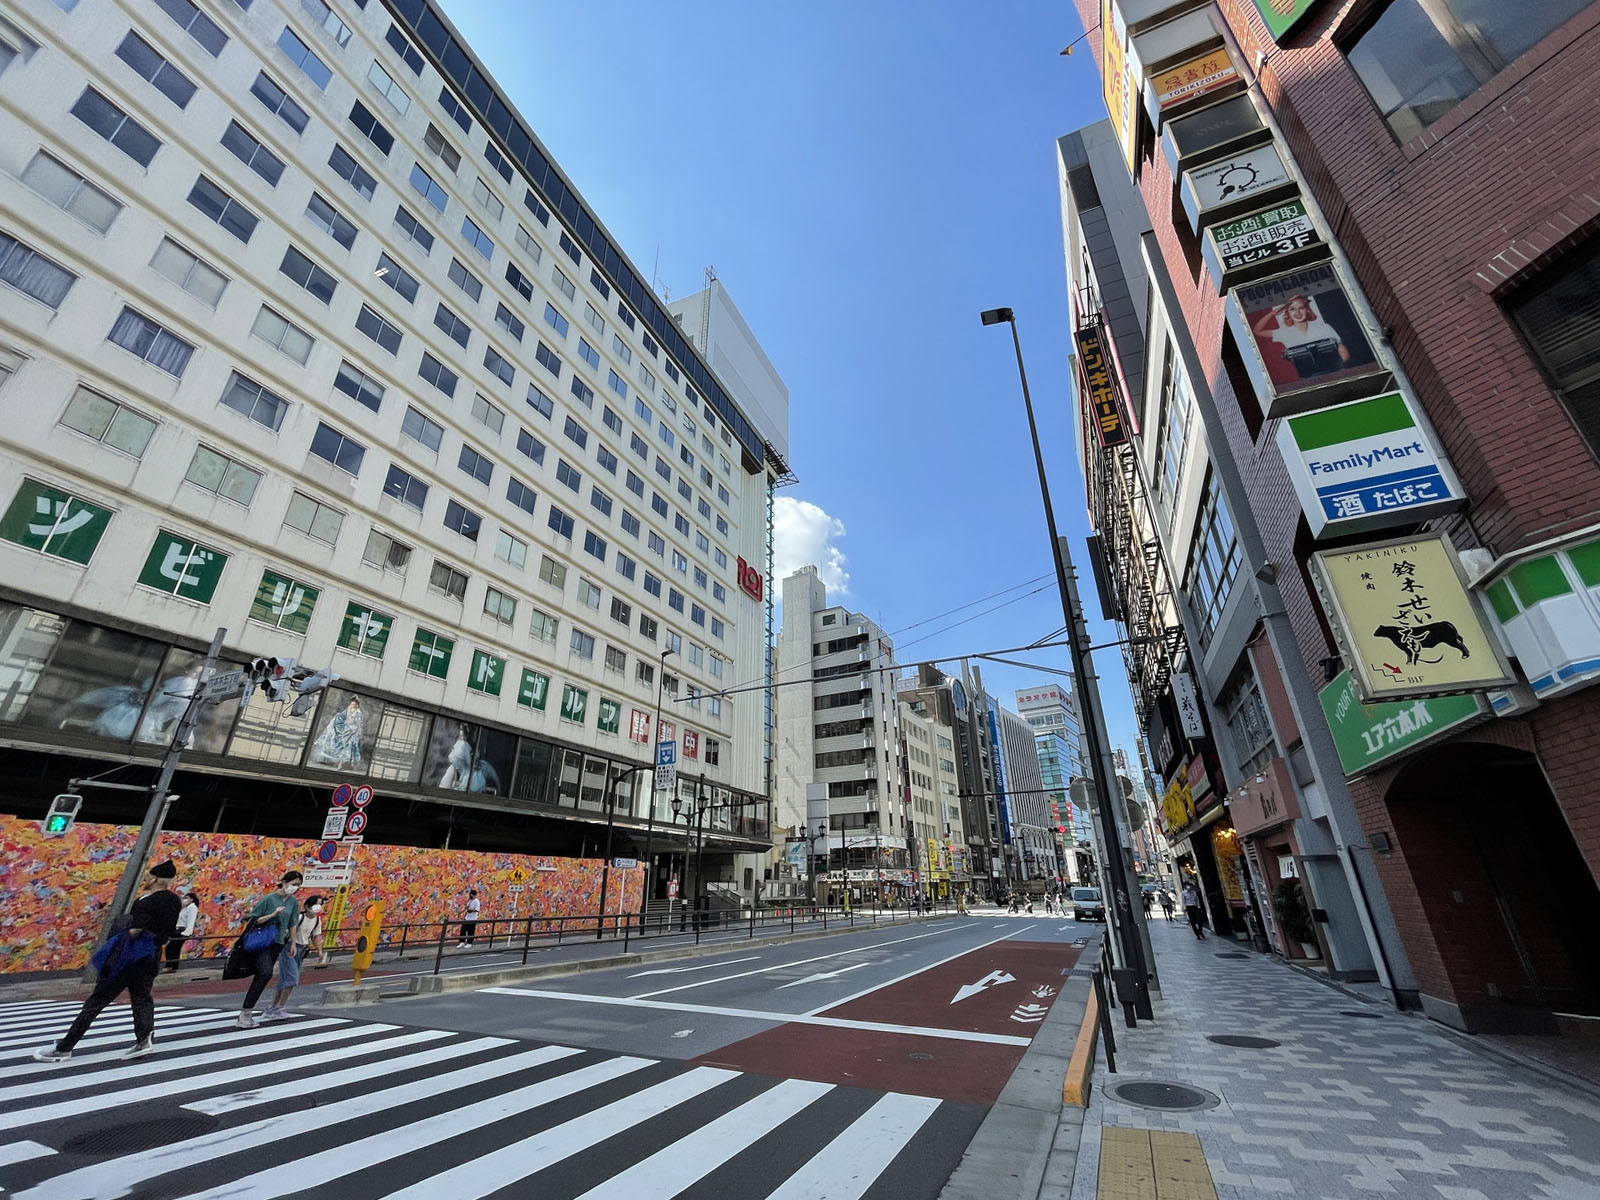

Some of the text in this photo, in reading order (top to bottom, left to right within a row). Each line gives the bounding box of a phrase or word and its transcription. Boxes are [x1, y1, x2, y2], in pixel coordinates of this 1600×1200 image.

[1168, 71, 1225, 98] TORIKIZOKU
[1217, 217, 1257, 239] お酒
[1261, 204, 1300, 228] 買取
[1222, 230, 1264, 255] お酒
[1269, 218, 1307, 239] 販売
[1228, 248, 1271, 266] 当ビル
[1275, 233, 1311, 254] 3F
[1309, 441, 1424, 476] FamilyMart
[1332, 482, 1438, 517] 酒 たばこ
[1344, 544, 1418, 563] YAKINIKU
[1360, 571, 1376, 591] 焼肉
[1407, 676, 1425, 684] B1F
[1335, 689, 1352, 724] YOUR
[357, 792, 369, 802] 40
